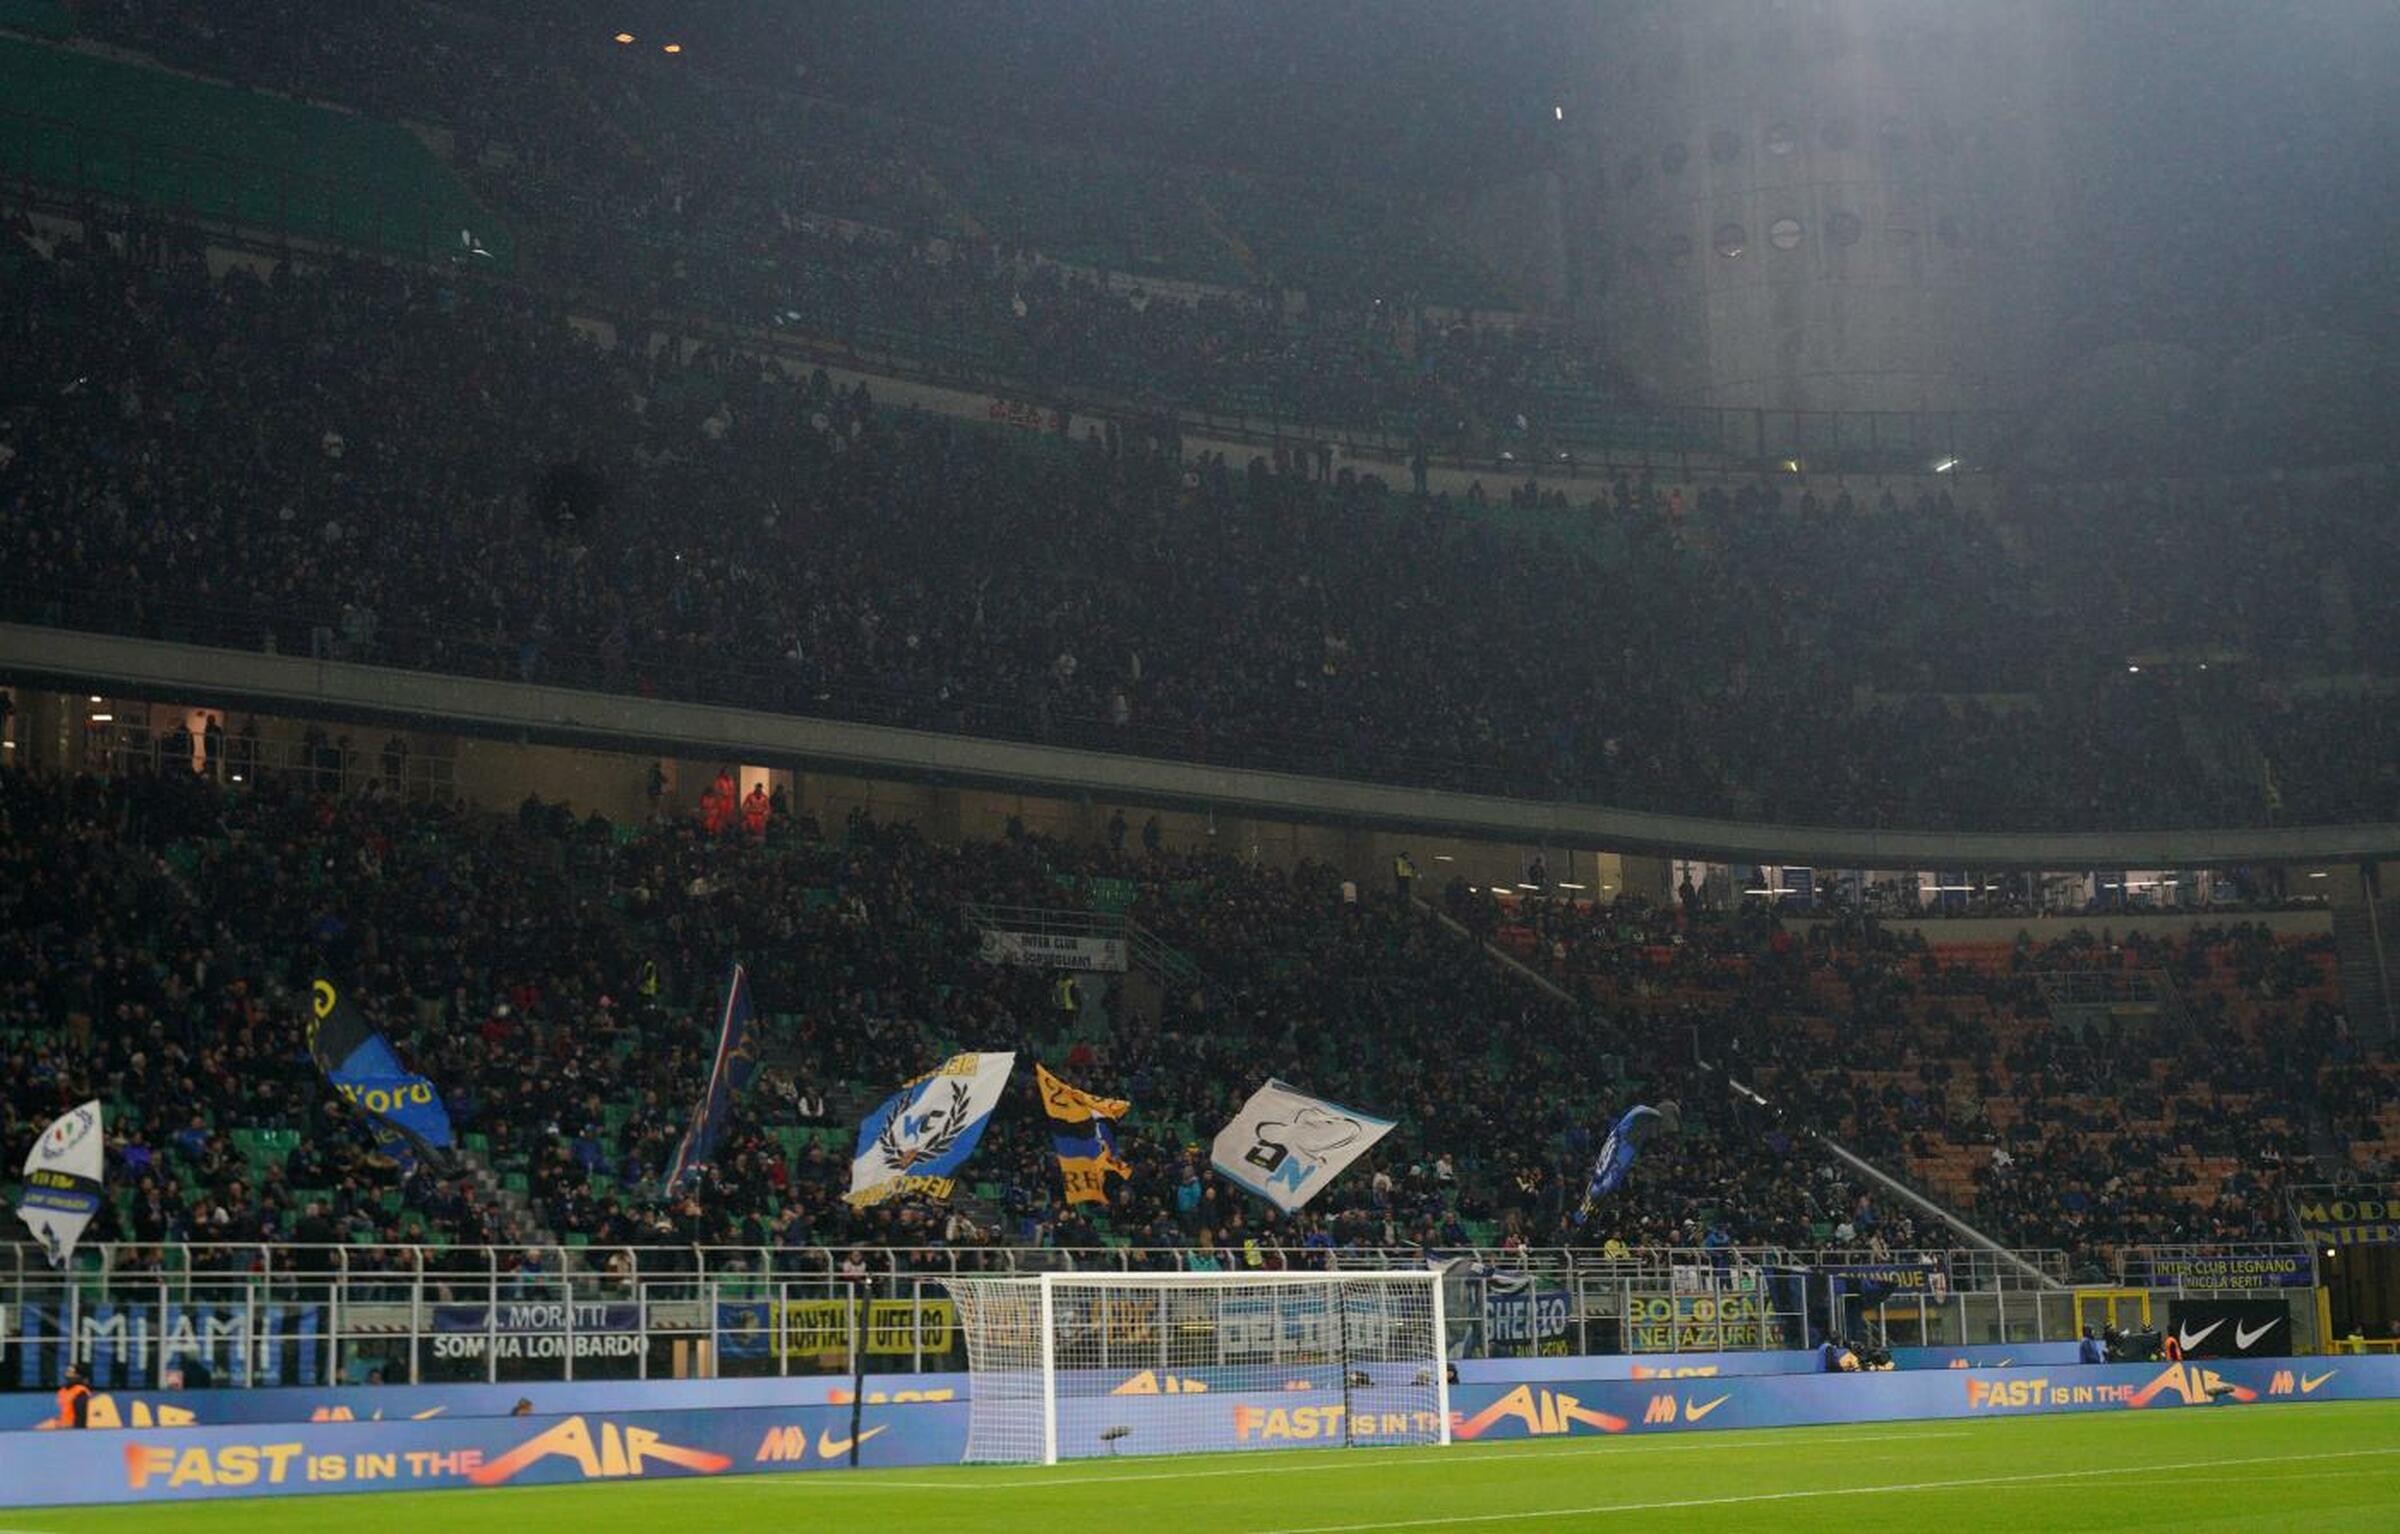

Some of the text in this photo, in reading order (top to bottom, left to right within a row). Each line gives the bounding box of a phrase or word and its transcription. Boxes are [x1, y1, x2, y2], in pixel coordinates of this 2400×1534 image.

[2157, 1258, 2297, 1275] INTER CLUB LEGNANO
[508, 1304, 608, 1329] MORATTI
[1630, 1299, 1777, 1323] BOLOGNA
[81, 1313, 271, 1371] MIAMI
[433, 1335, 650, 1358] SOMMA LOMBARDO
[1965, 1361, 2257, 1409] FAST IS IN THE AIR
[1233, 1403, 1346, 1440] FAST
[1350, 1414, 1375, 1434] IS
[1382, 1412, 1407, 1434] IN
[1453, 1384, 1628, 1439] AIR
[123, 1415, 732, 1488] FAST IS IN THE AIR
